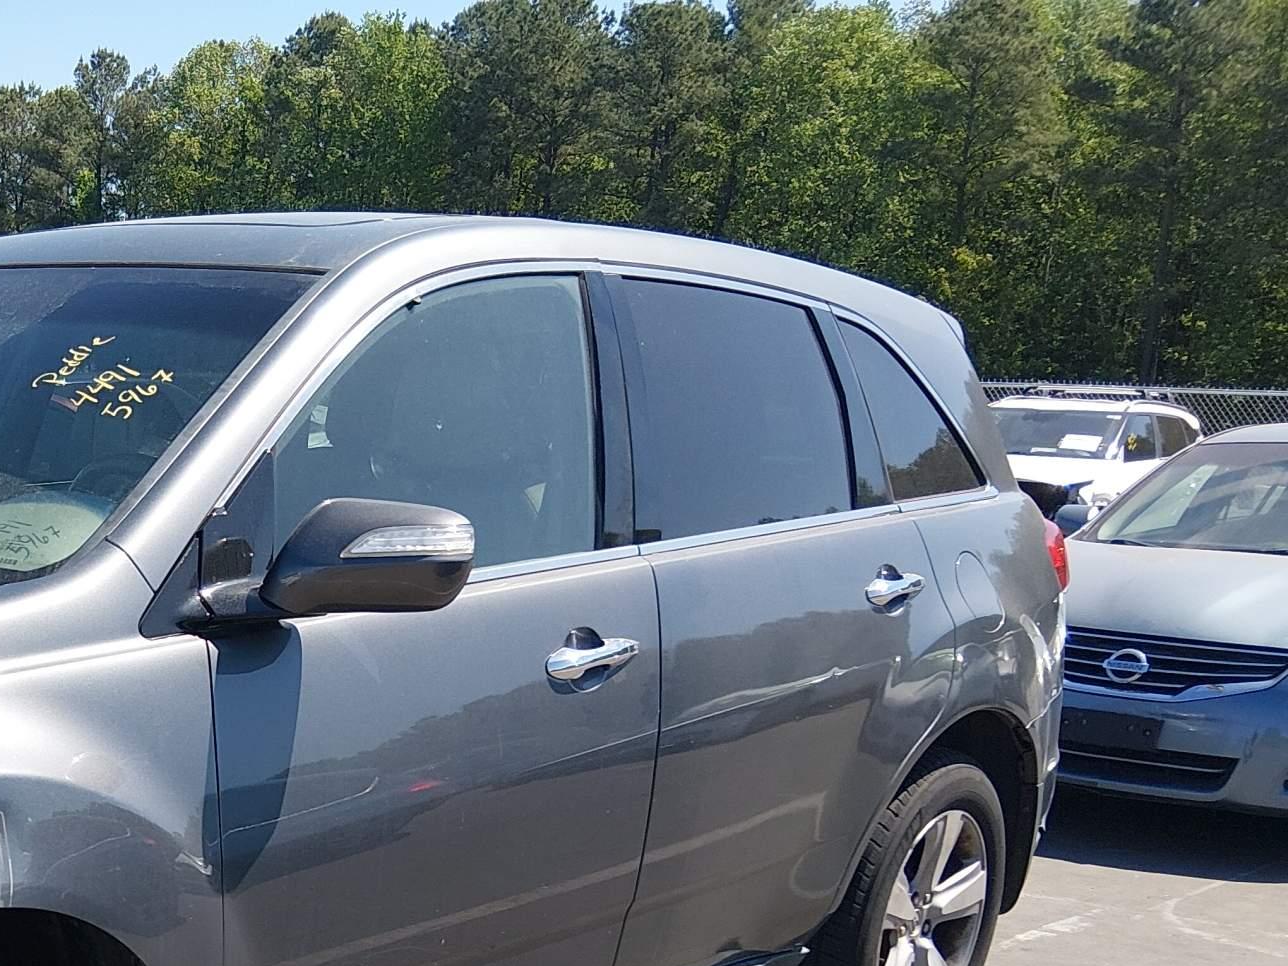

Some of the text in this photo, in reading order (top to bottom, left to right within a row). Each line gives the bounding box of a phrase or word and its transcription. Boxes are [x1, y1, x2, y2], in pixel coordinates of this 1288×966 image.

[70, 363, 142, 408] 4491
[100, 368, 175, 421] 5967
[1106, 660, 1146, 672] NISSAN
